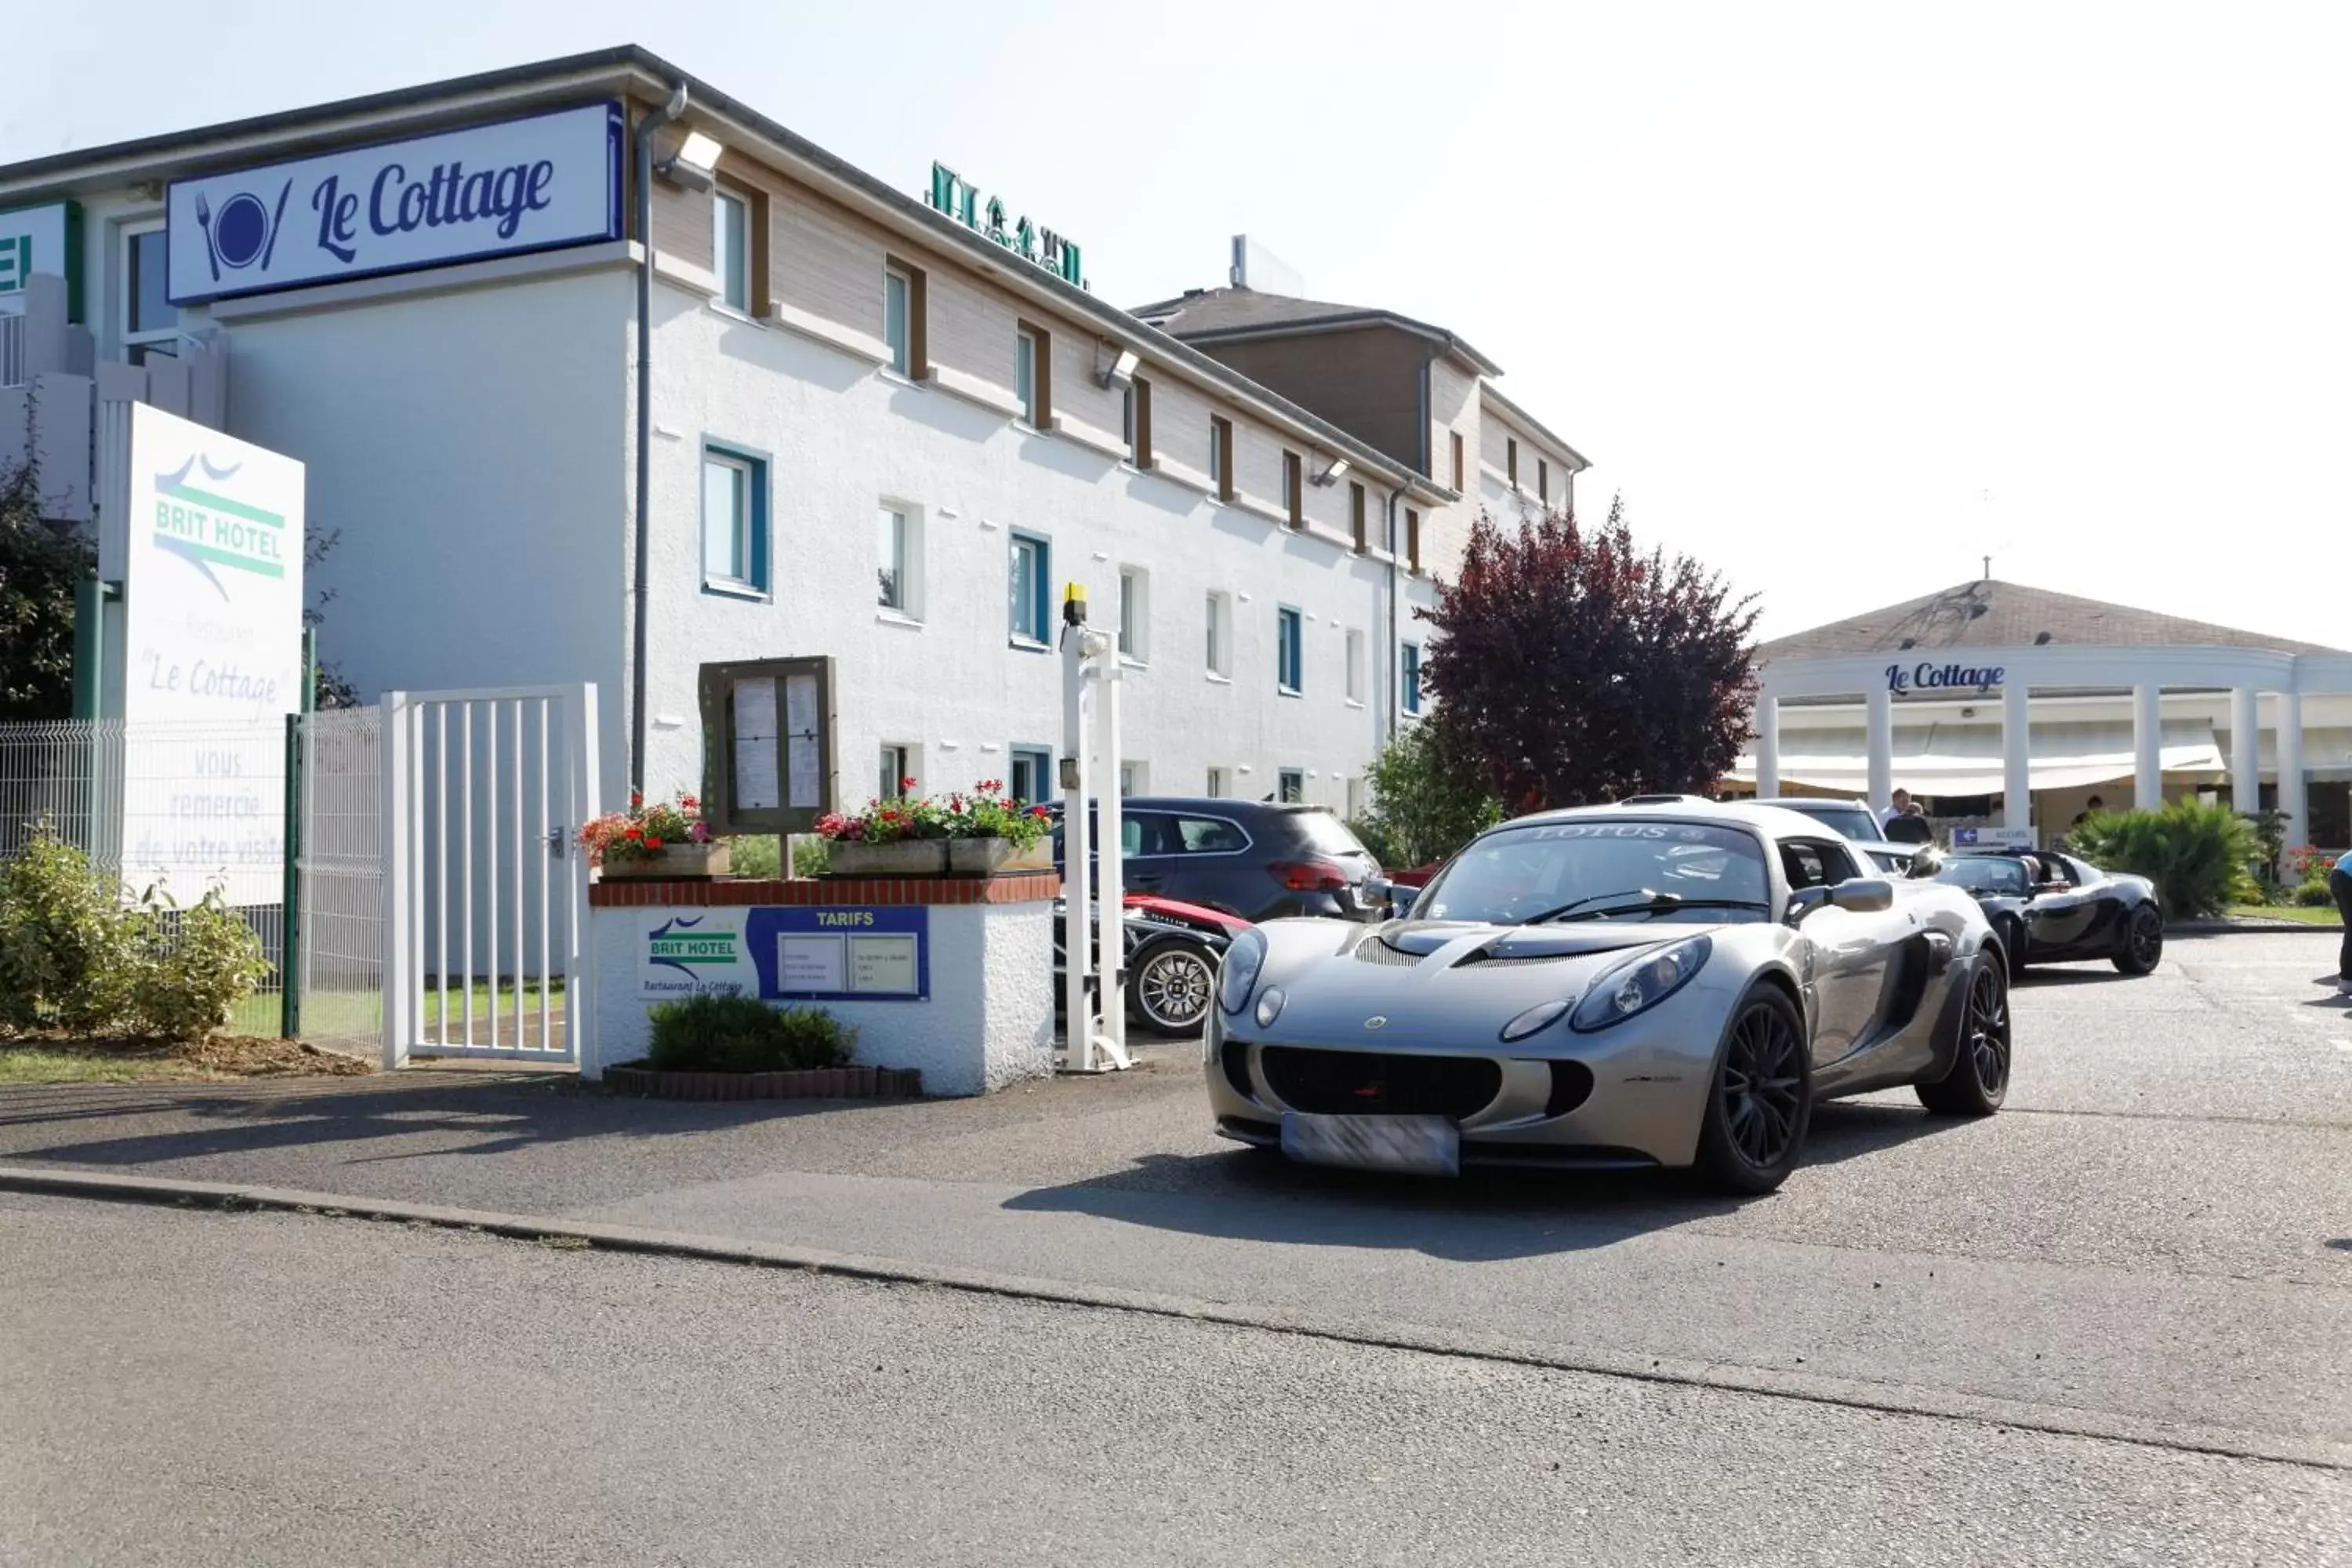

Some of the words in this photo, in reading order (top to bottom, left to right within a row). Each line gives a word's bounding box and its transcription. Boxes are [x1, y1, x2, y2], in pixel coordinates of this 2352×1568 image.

[312, 174, 359, 263] Le
[368, 160, 554, 240] Cottage
[157, 499, 208, 539] BRIT
[214, 517, 282, 559] HOTEL
[1885, 664, 1909, 696] Le
[1914, 662, 2005, 692] Cottage
[195, 749, 241, 776] vous
[171, 787, 260, 821] remercie
[1534, 826, 1669, 840] LOTUS
[816, 912, 874, 926] TARIFS
[652, 942, 683, 954] BRIT
[688, 942, 736, 954] HOTEL
